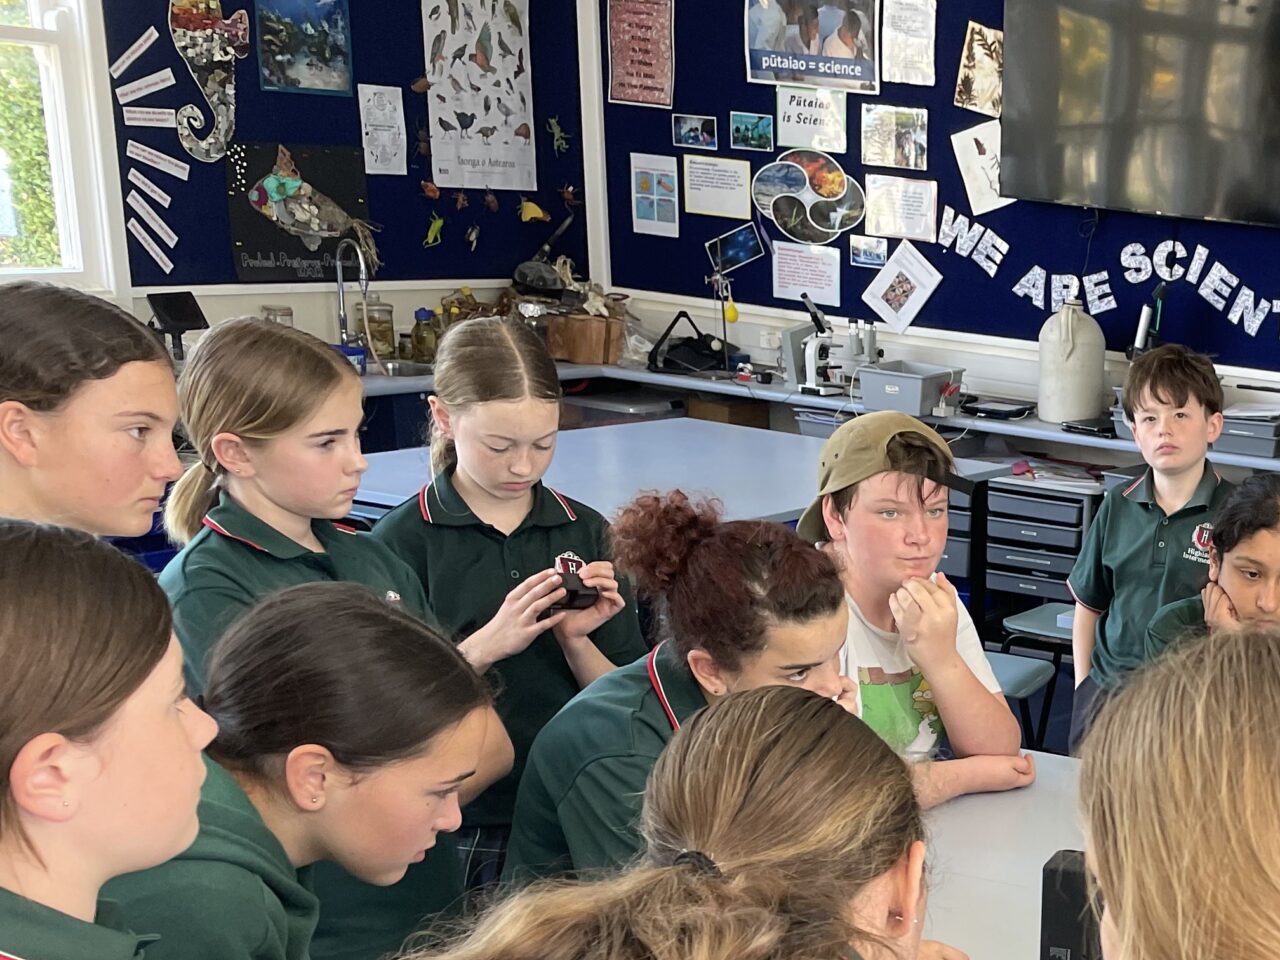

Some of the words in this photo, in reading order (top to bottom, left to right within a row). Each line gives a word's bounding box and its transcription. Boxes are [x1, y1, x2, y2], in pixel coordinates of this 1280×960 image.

[762, 55, 806, 70] pūtaiao
[818, 60, 862, 76] science
[782, 112, 791, 123] is
[938, 205, 1010, 279] WE
[1011, 264, 1118, 316] ARE
